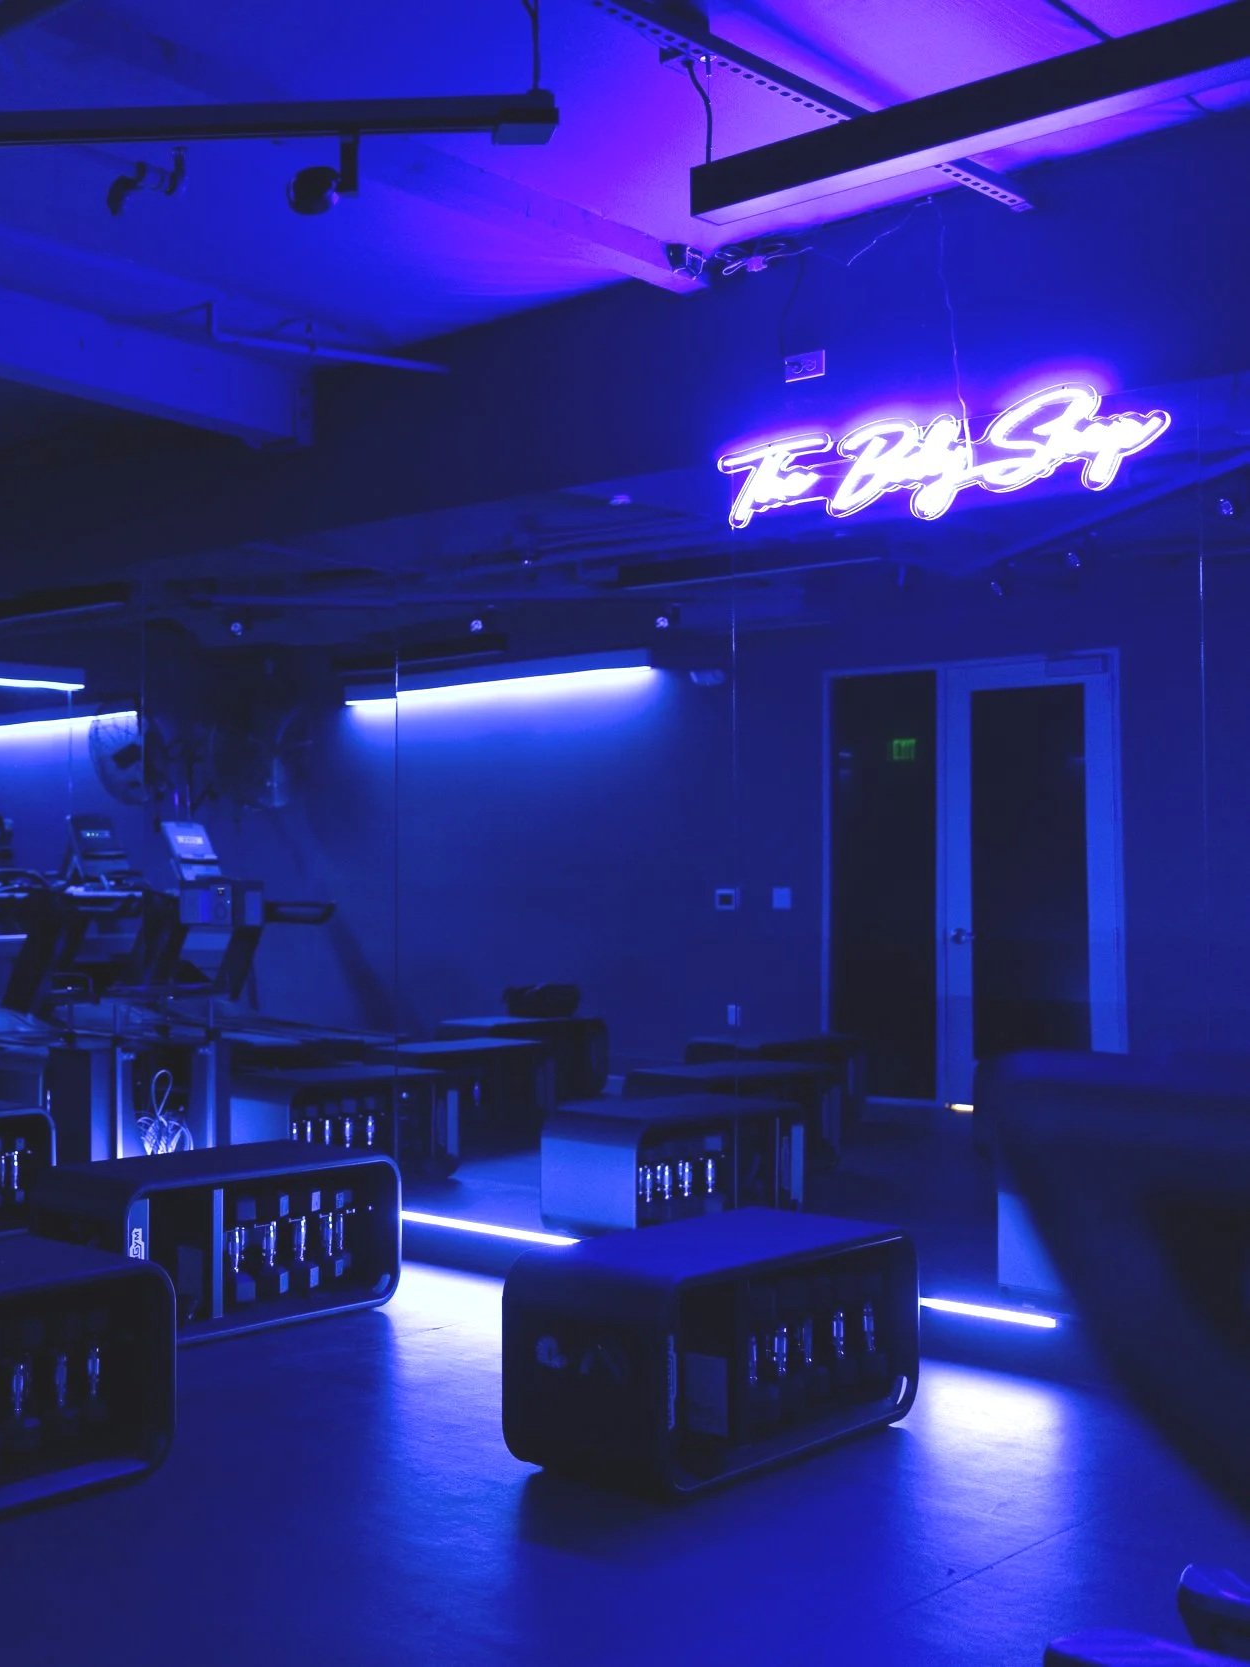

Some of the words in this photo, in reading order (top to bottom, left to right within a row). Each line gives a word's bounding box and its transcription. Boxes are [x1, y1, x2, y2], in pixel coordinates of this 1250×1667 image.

[718, 433, 831, 528] The
[828, 414, 970, 520] Body
[974, 383, 1171, 490] Shop
